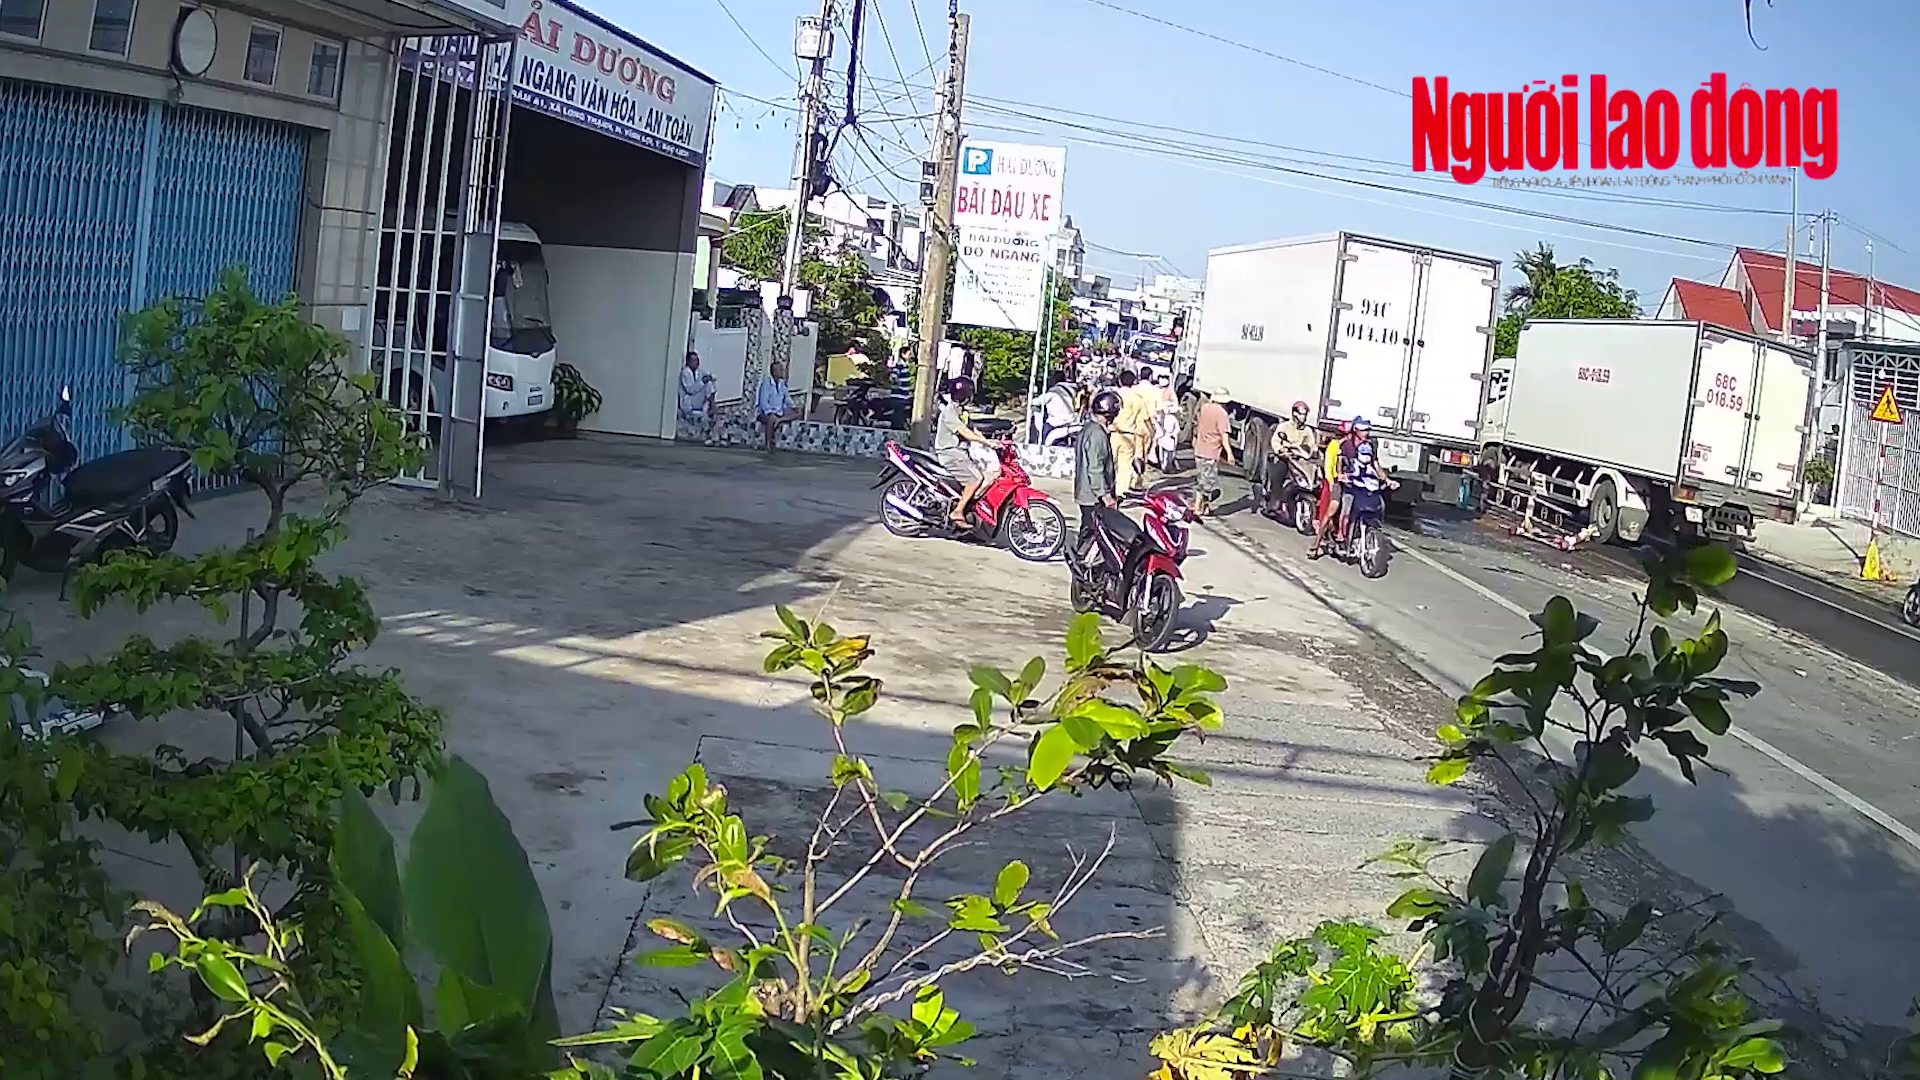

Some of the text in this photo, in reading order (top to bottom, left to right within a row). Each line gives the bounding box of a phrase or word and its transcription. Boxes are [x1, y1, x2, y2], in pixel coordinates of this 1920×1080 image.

[519, 0, 563, 54] ẢI
[570, 31, 677, 105] DƯƠNG
[519, 55, 577, 102] NGANG
[609, 89, 636, 126] HÓA
[644, 106, 663, 135] AN
[664, 114, 694, 146] TOÀN
[968, 149, 989, 172] P
[957, 181, 986, 216] BÃI
[1028, 192, 1052, 222] XE
[990, 248, 1040, 263] NGANG
[1715, 372, 1737, 392] 68C
[1706, 388, 1743, 412] 018.59
